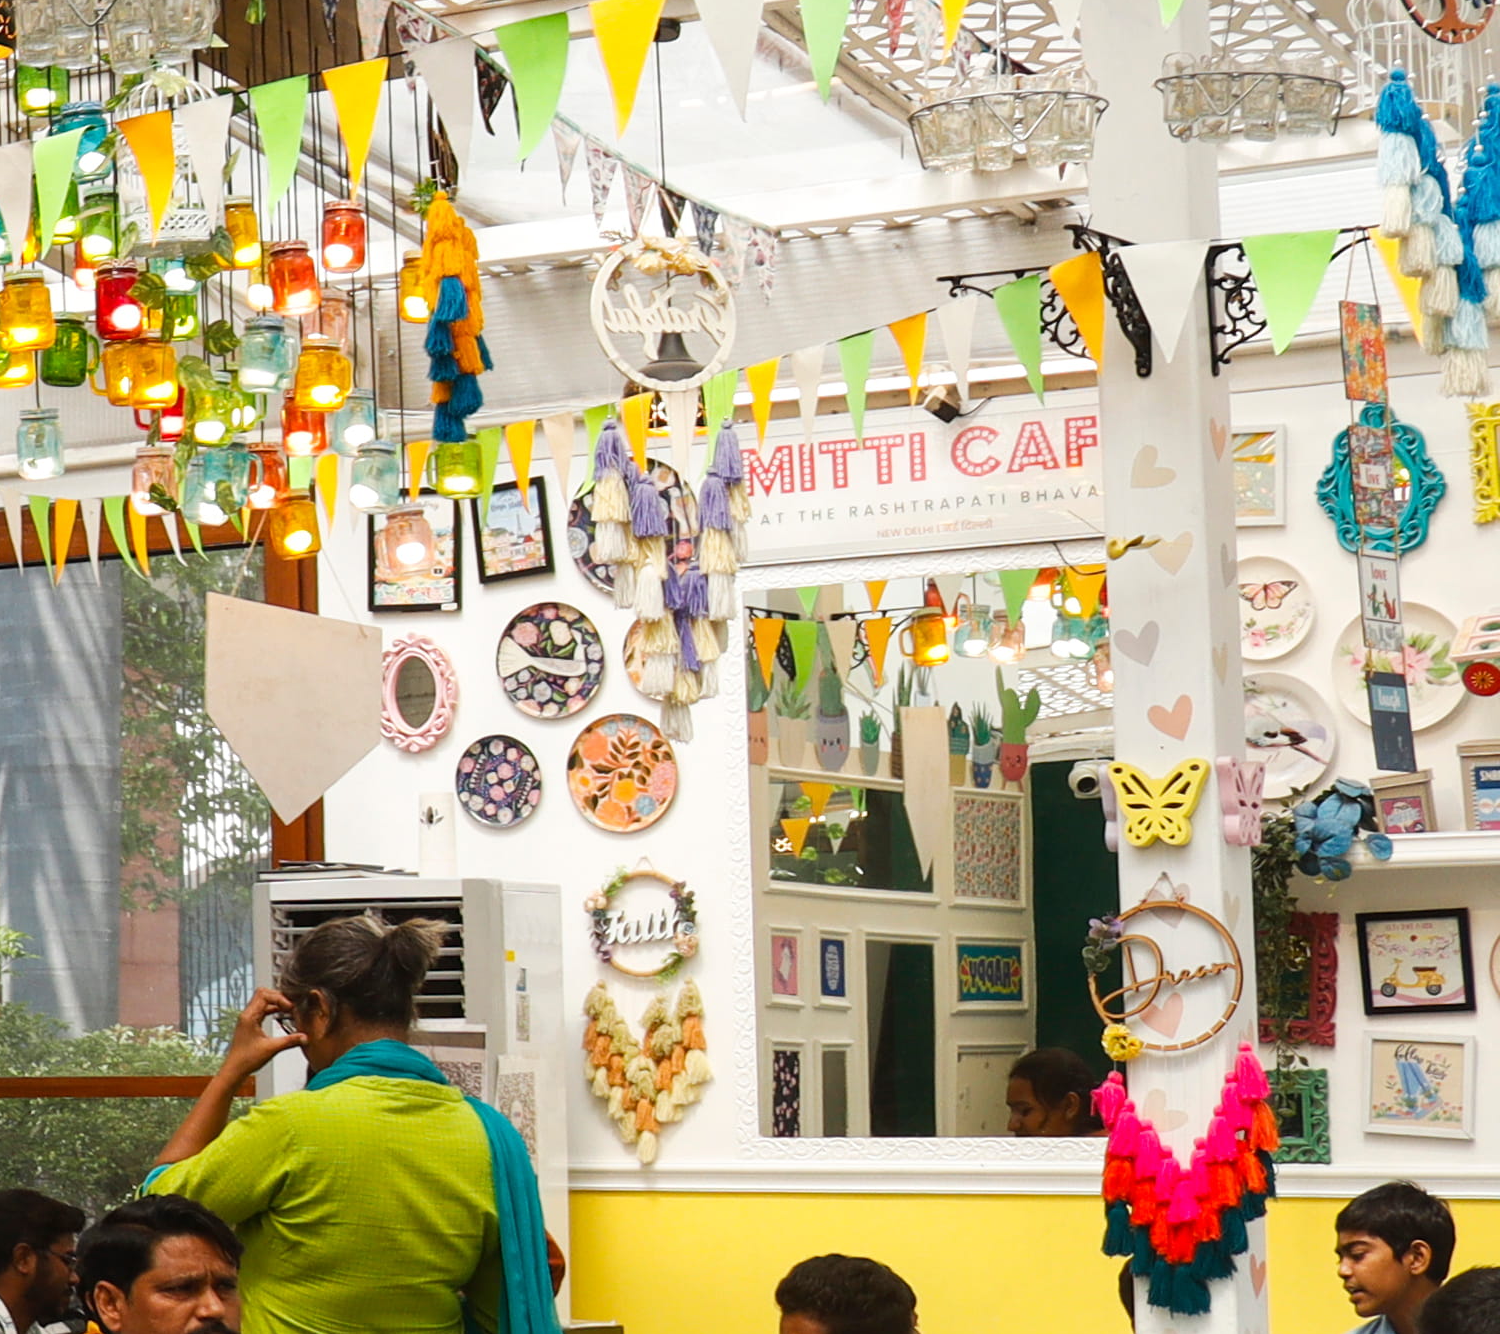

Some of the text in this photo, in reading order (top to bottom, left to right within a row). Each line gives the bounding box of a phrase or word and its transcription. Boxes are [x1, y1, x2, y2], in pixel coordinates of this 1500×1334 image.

[740, 415, 1099, 497] MITTI CAF
[798, 505, 837, 523] THE
[848, 492, 1007, 519] RASHTRAPATI
[1020, 484, 1100, 505] BHAVA
[1100, 934, 1237, 1019] Dream
